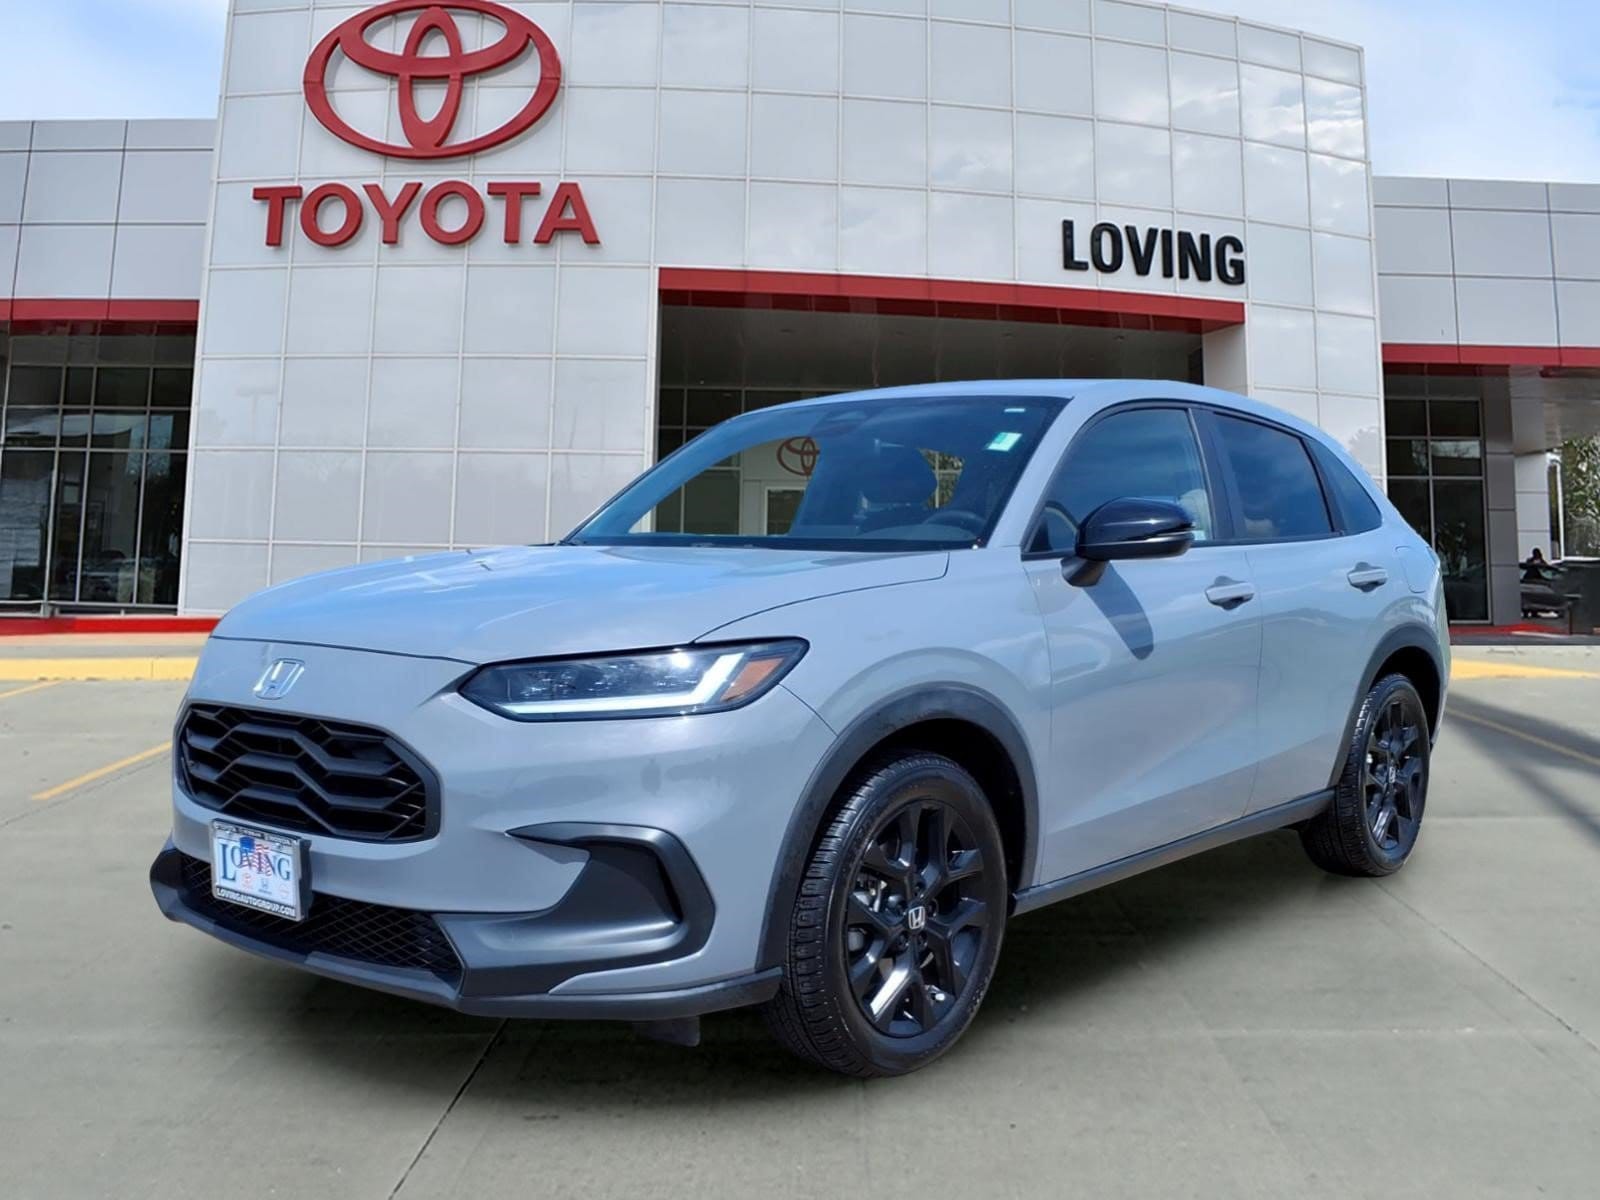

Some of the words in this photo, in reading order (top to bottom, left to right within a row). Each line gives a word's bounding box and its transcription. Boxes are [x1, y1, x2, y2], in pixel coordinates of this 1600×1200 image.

[252, 180, 601, 247] TOYOTA
[1062, 219, 1246, 286] LOVING
[220, 842, 292, 882] LOVING
